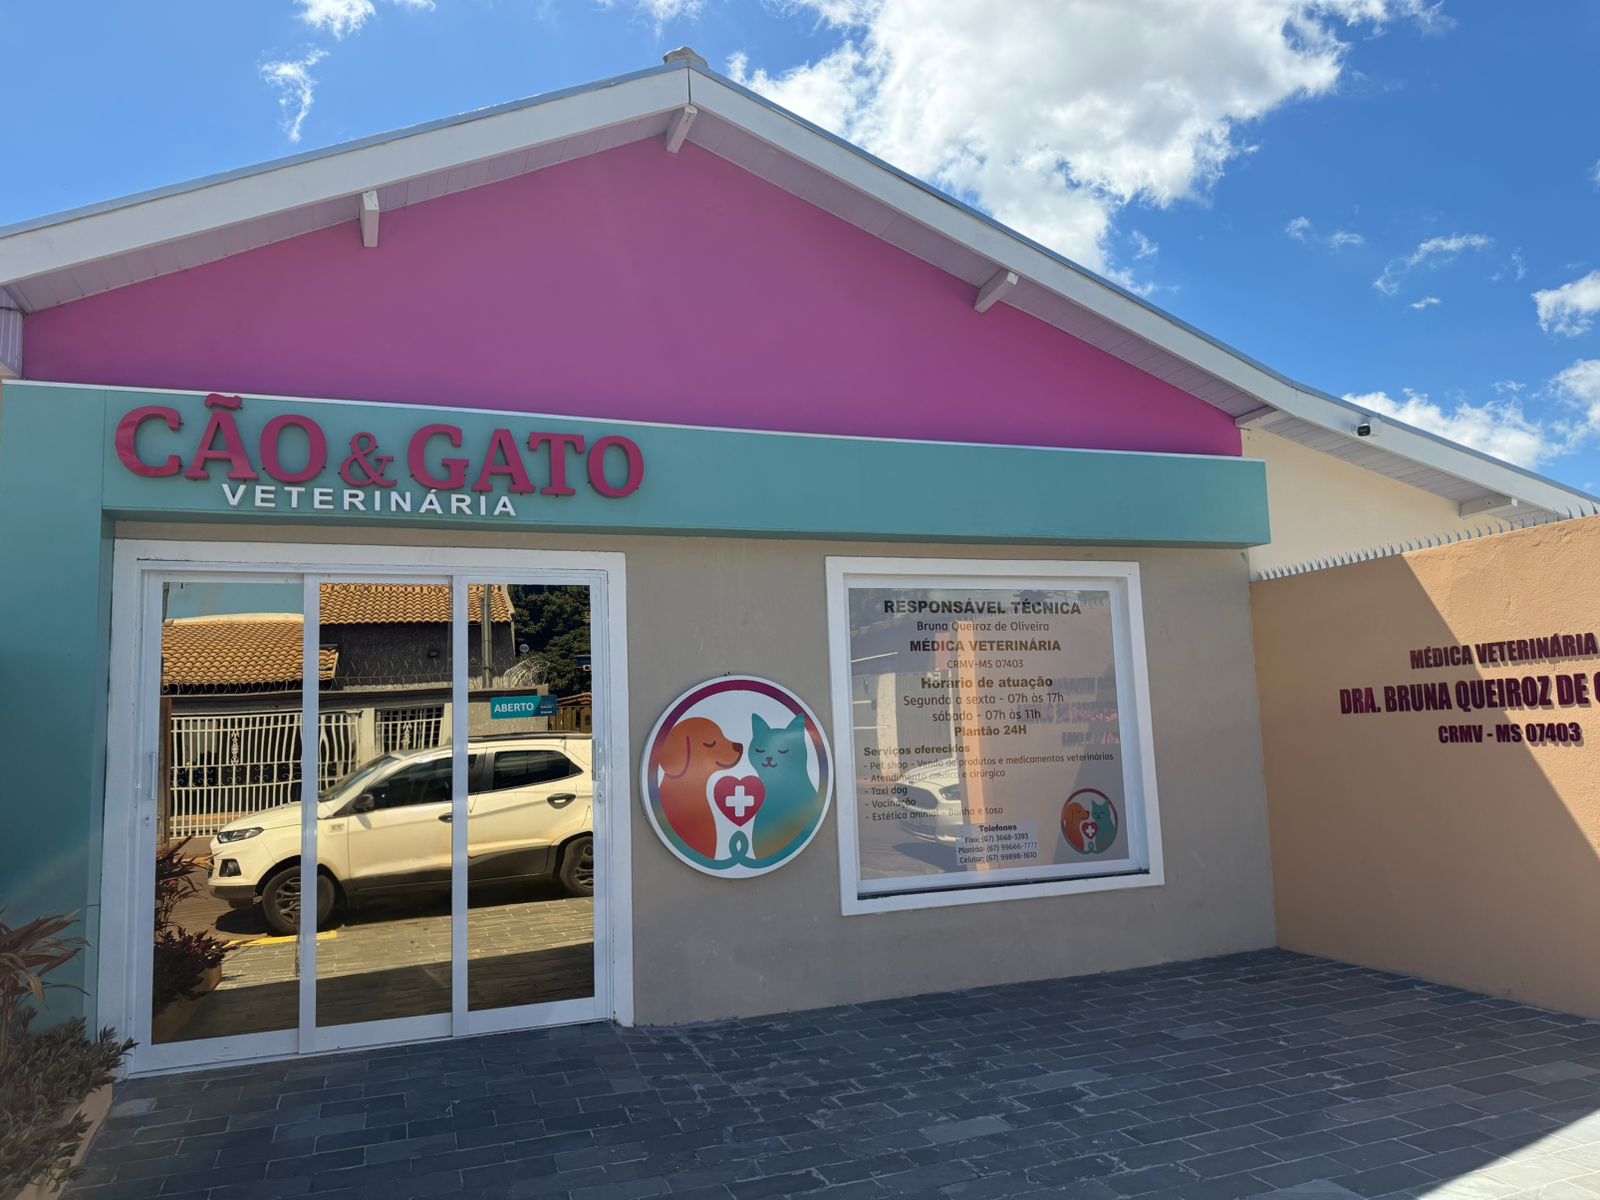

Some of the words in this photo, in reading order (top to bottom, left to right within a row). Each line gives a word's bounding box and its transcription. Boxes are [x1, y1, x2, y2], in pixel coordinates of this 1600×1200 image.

[221, 483, 517, 516] VETERINÁRIA
[884, 598, 1006, 614] RESPONSÁVEL
[1011, 599, 1081, 614] TÉCNICA
[917, 622, 948, 631] Bruna
[952, 622, 991, 632] Queiroz
[995, 621, 1006, 631] de
[1010, 621, 1049, 631] Oliveira
[910, 638, 965, 651] MÉDICA
[969, 637, 1061, 651] VETERINÁRIA
[1410, 645, 1473, 669] MÉDICA
[1475, 632, 1598, 664] VETERINÁRIA
[947, 660, 992, 669] CRMV-MS
[995, 660, 1023, 668] 07403
[921, 677, 973, 688] Horário
[977, 677, 993, 688] de
[999, 675, 1053, 690] atuação
[904, 695, 951, 708] Segunda
[966, 696, 996, 704] sexta
[1007, 693, 1028, 704] 07h
[1032, 693, 1044, 703] às
[1047, 692, 1064, 702] 17h
[1339, 687, 1381, 714] DRA.
[1384, 682, 1453, 713] BRUNA
[1455, 675, 1551, 712] QUEIROZ
[1556, 673, 1589, 706] DE
[494, 702, 534, 712] ABERTO
[932, 711, 973, 721] sábado
[985, 710, 1005, 720] 07h
[1025, 709, 1041, 719] 11h
[955, 726, 1000, 736] Plantão
[1003, 725, 1027, 735] 24H
[1438, 724, 1483, 743] CRMV
[1495, 724, 1522, 743] MS
[1525, 722, 1581, 743] 07403
[864, 747, 911, 757] Serviços
[914, 744, 970, 754] oferecidos
[870, 762, 884, 770] Pet
[887, 761, 908, 771] shop
[917, 759, 943, 767] Venda
[958, 756, 996, 768] produtos
[1005, 754, 1065, 765] medicamentos
[1066, 751, 1114, 762] veterinários
[871, 772, 927, 782] Atendimento
[929, 771, 959, 780] médico
[969, 769, 1005, 779] cirúrgico
[871, 787, 888, 795] Taxi
[891, 786, 908, 796] dog
[872, 798, 916, 808] Vacinação
[872, 811, 907, 821] Estética
[910, 810, 939, 819] animal
[948, 807, 974, 816] Banho
[985, 807, 1003, 815] tosa
[979, 824, 1017, 832] Telefones
